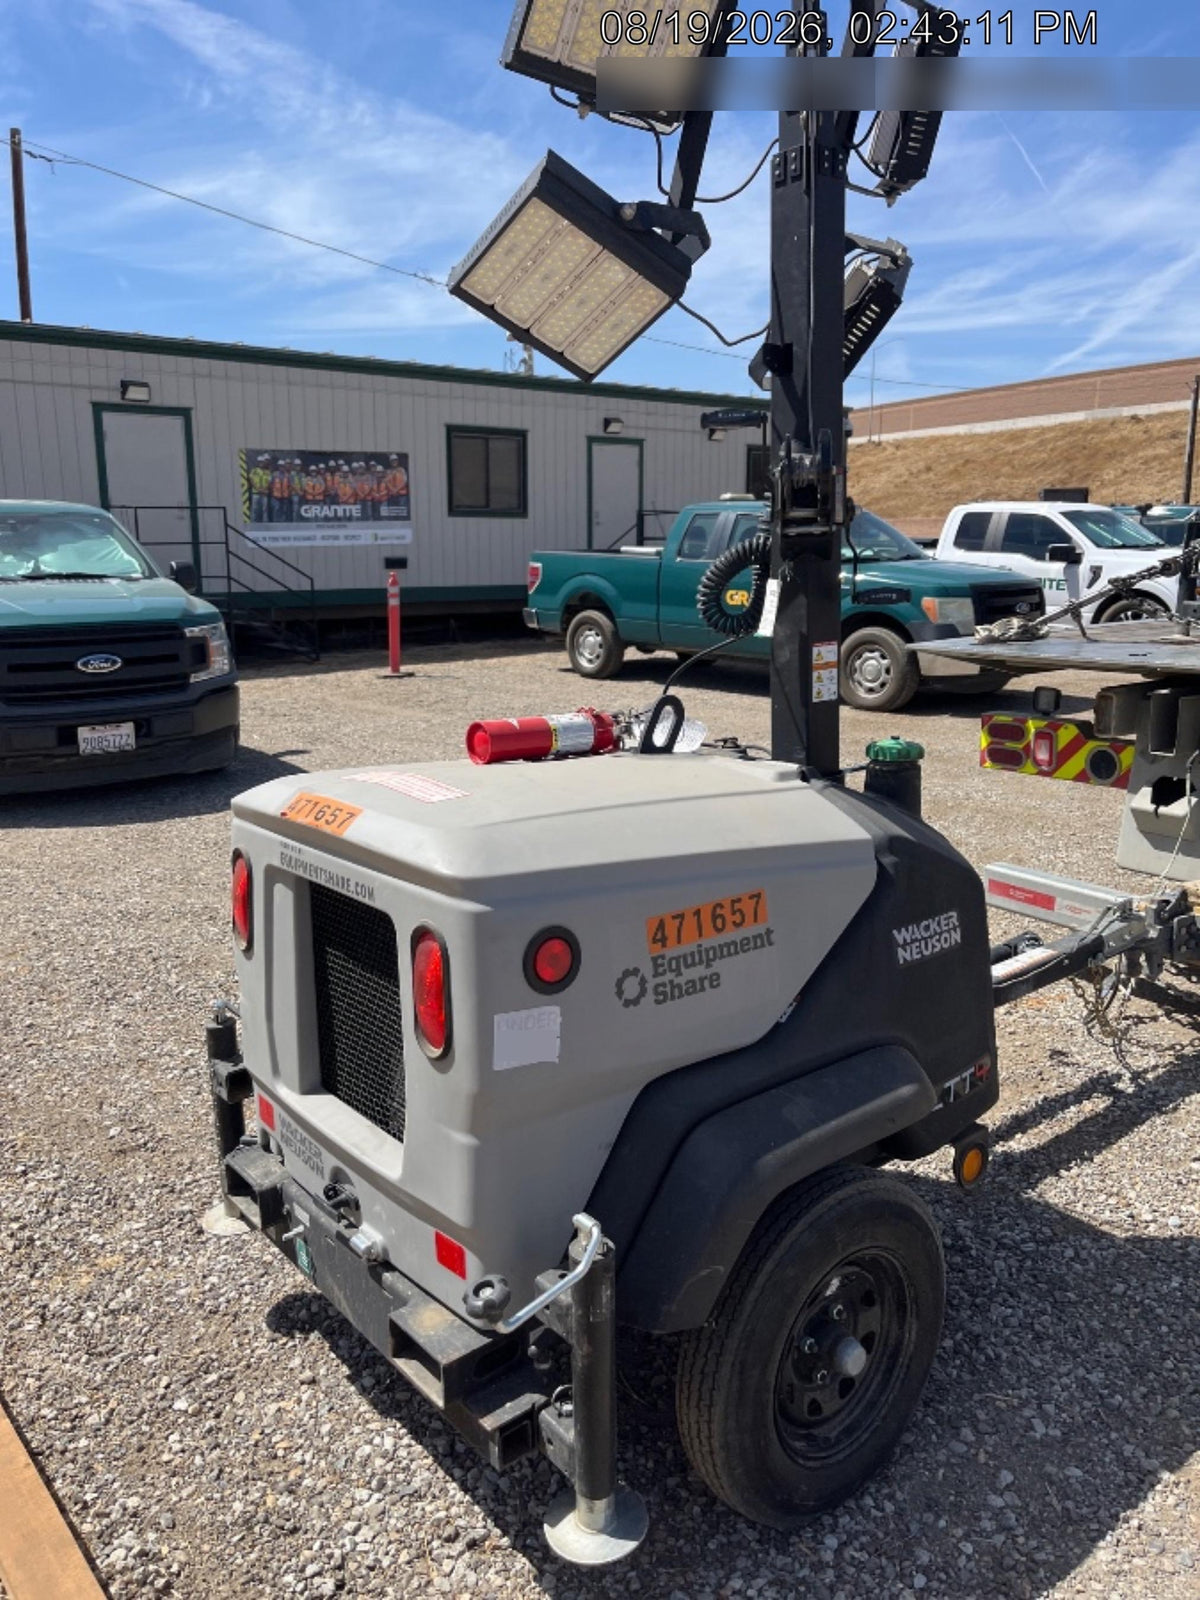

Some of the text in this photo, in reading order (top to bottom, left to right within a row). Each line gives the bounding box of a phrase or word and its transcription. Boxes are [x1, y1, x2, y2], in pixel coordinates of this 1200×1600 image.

[300, 504, 362, 518] GRANITE
[652, 892, 762, 949] 471657
[892, 911, 960, 945] WACKER
[650, 927, 775, 978] Equipment
[898, 927, 962, 965] NEUSON
[652, 971, 721, 1006] Share
